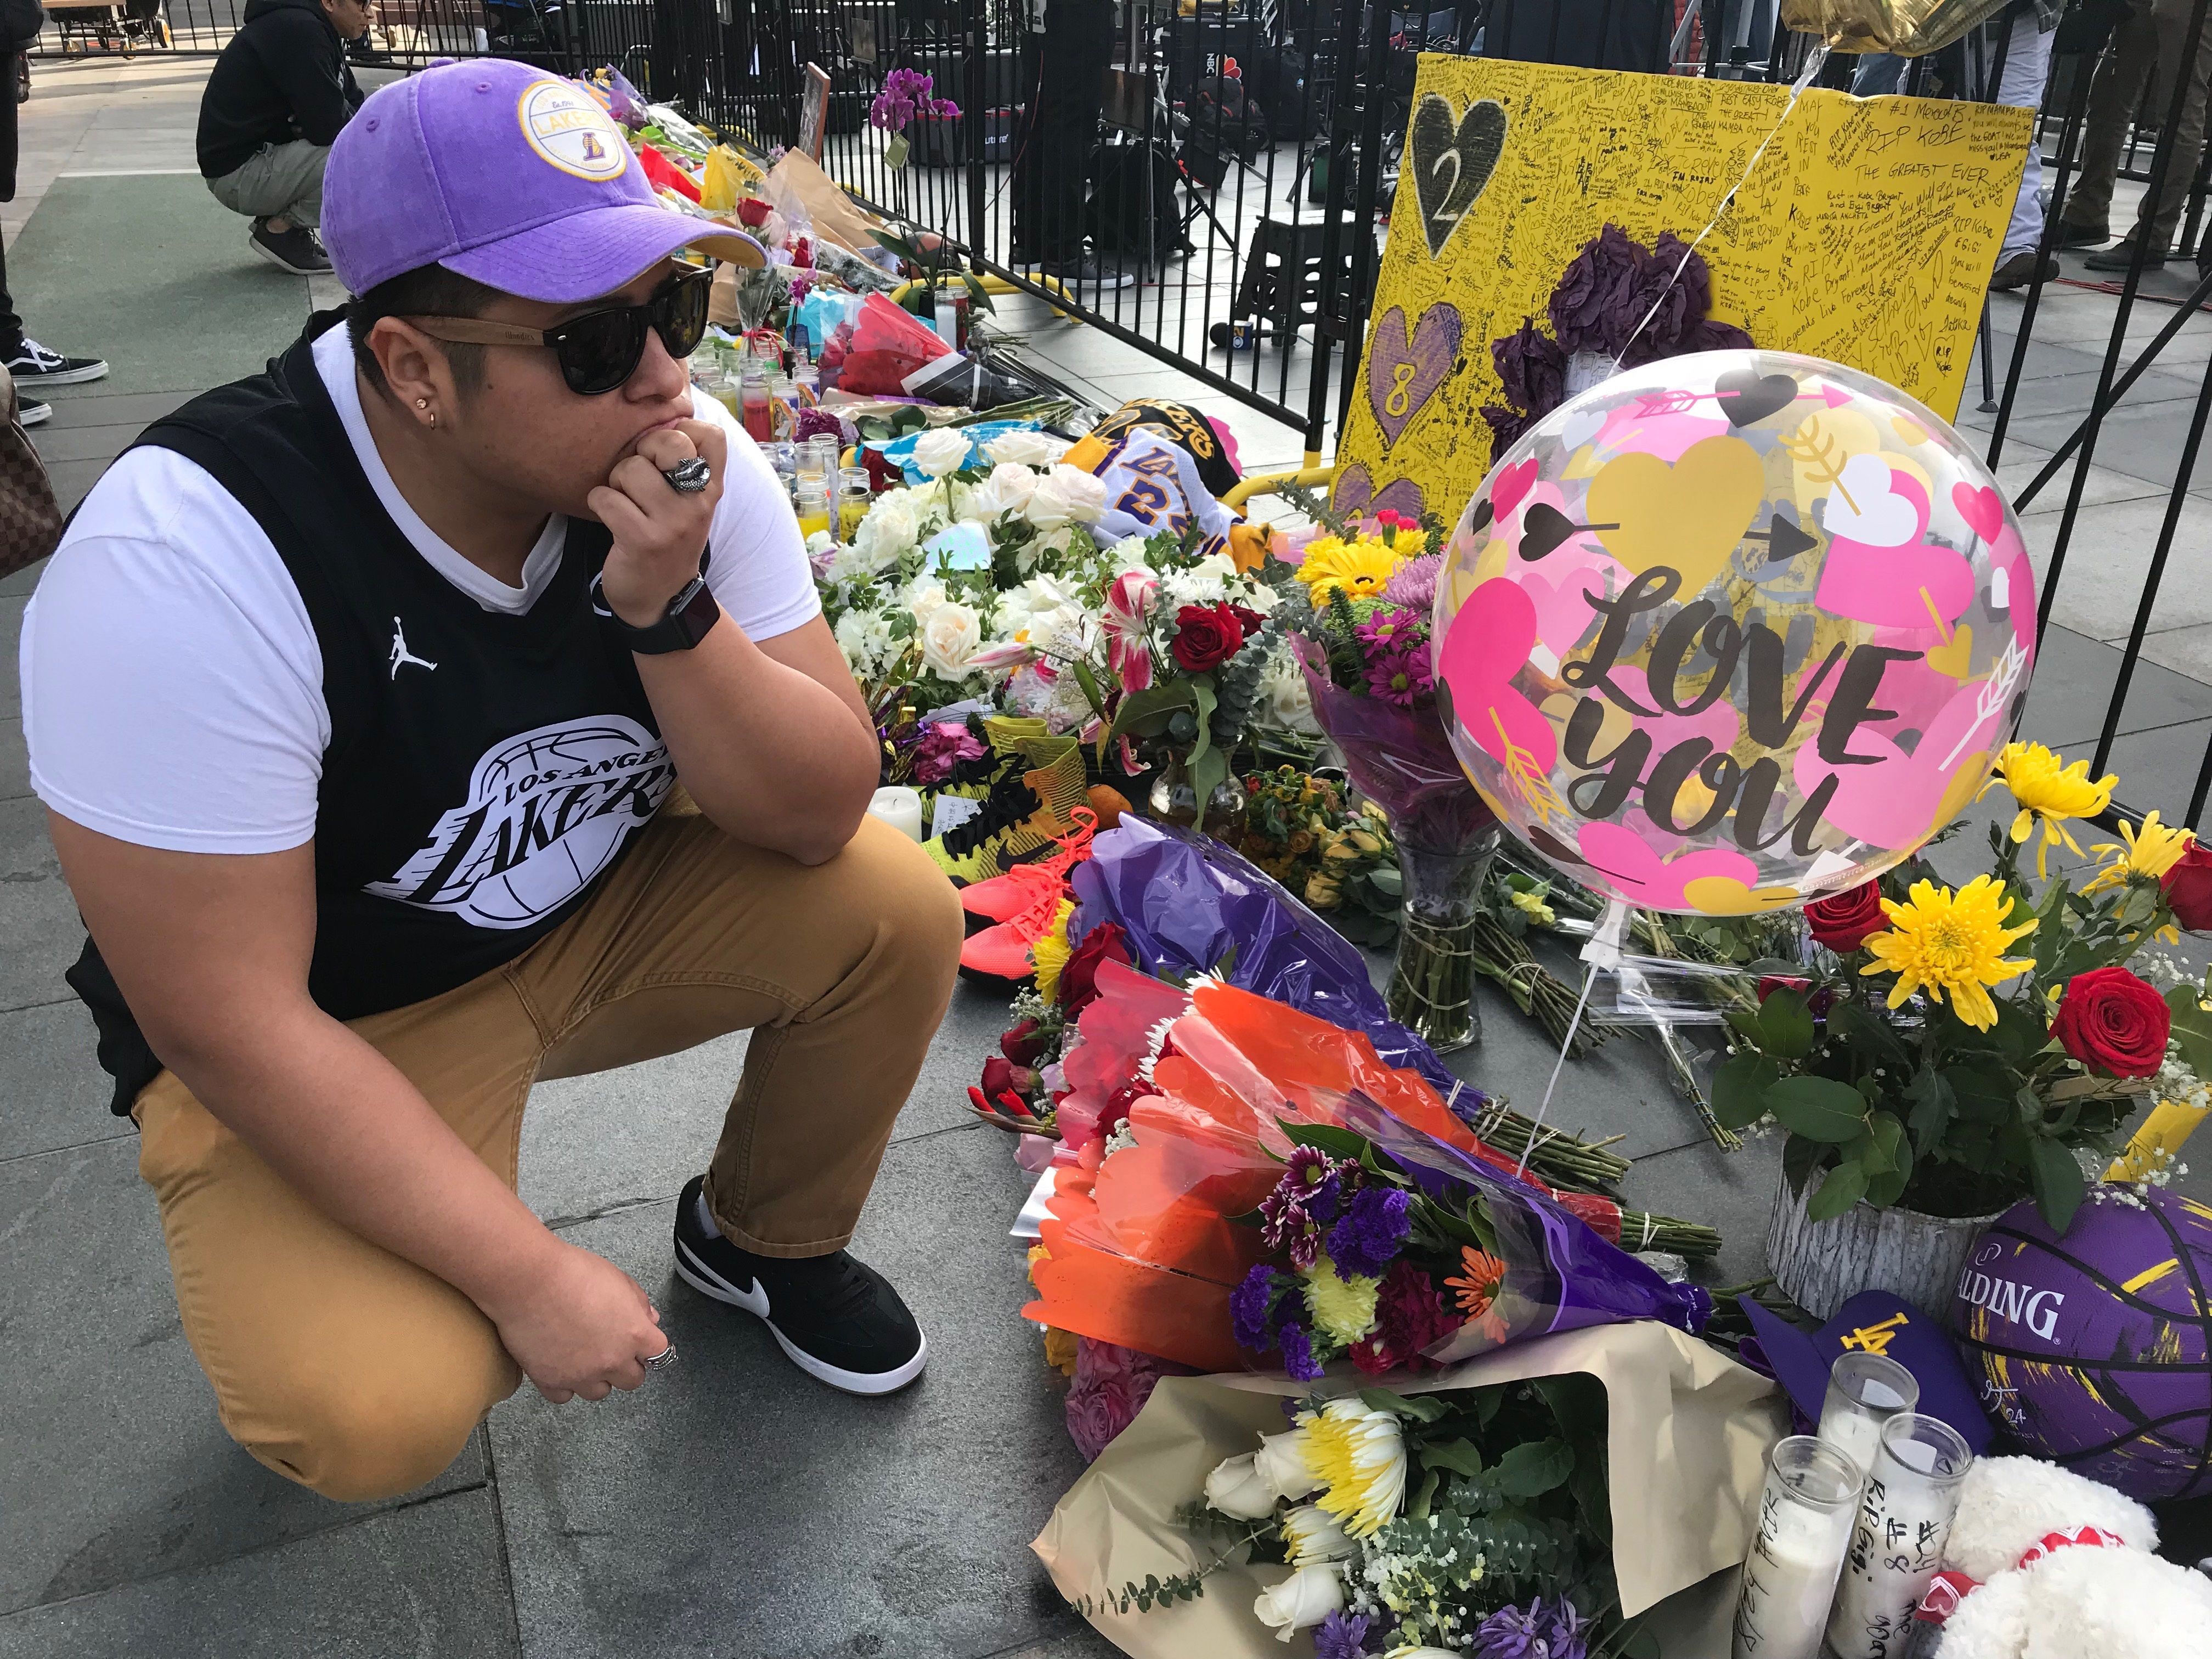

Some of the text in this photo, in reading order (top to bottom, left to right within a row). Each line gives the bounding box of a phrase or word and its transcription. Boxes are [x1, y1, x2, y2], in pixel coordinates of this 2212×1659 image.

[1206, 53, 1215, 74] NBC
[1742, 94, 1762, 110] EASY
[1764, 94, 1791, 109] KOBE
[1889, 99, 1908, 116] #1
[1974, 104, 1987, 116] RIP
[1795, 132, 1818, 156] REST
[1916, 122, 1966, 147] KOBE
[1970, 132, 1982, 142] the
[1799, 156, 1810, 173] IN
[1432, 149, 1462, 221] 2
[1854, 164, 1880, 186] THE
[1951, 163, 1990, 188] EVER
[1745, 181, 1757, 193] the
[1827, 189, 1846, 201] Rest
[1857, 211, 1895, 236] Forever
[1953, 216, 1972, 234] RIP
[1716, 256, 1731, 268] Thank
[1745, 261, 1753, 273] for
[1803, 253, 1831, 287] RIP
[1965, 261, 1982, 272] will
[1744, 276, 1760, 287] RIP
[1511, 291, 1524, 301] RIP
[1531, 289, 1549, 309] RIP
[1792, 285, 1822, 316] Kobe
[1781, 315, 1816, 351] Legends
[1385, 362, 1417, 417] 8
[1454, 459, 1473, 475] RIP
[1452, 476, 1472, 489] KOBE
[1561, 566, 1925, 765] LOVE
[1564, 696, 1839, 856] YOU
[505, 770, 564, 805] LOS
[403, 763, 679, 904] LAKERS
[1957, 1265, 2066, 1341] ALDING
[1840, 1312, 1910, 1356] LA
[2006, 1408, 2027, 1425] 24
